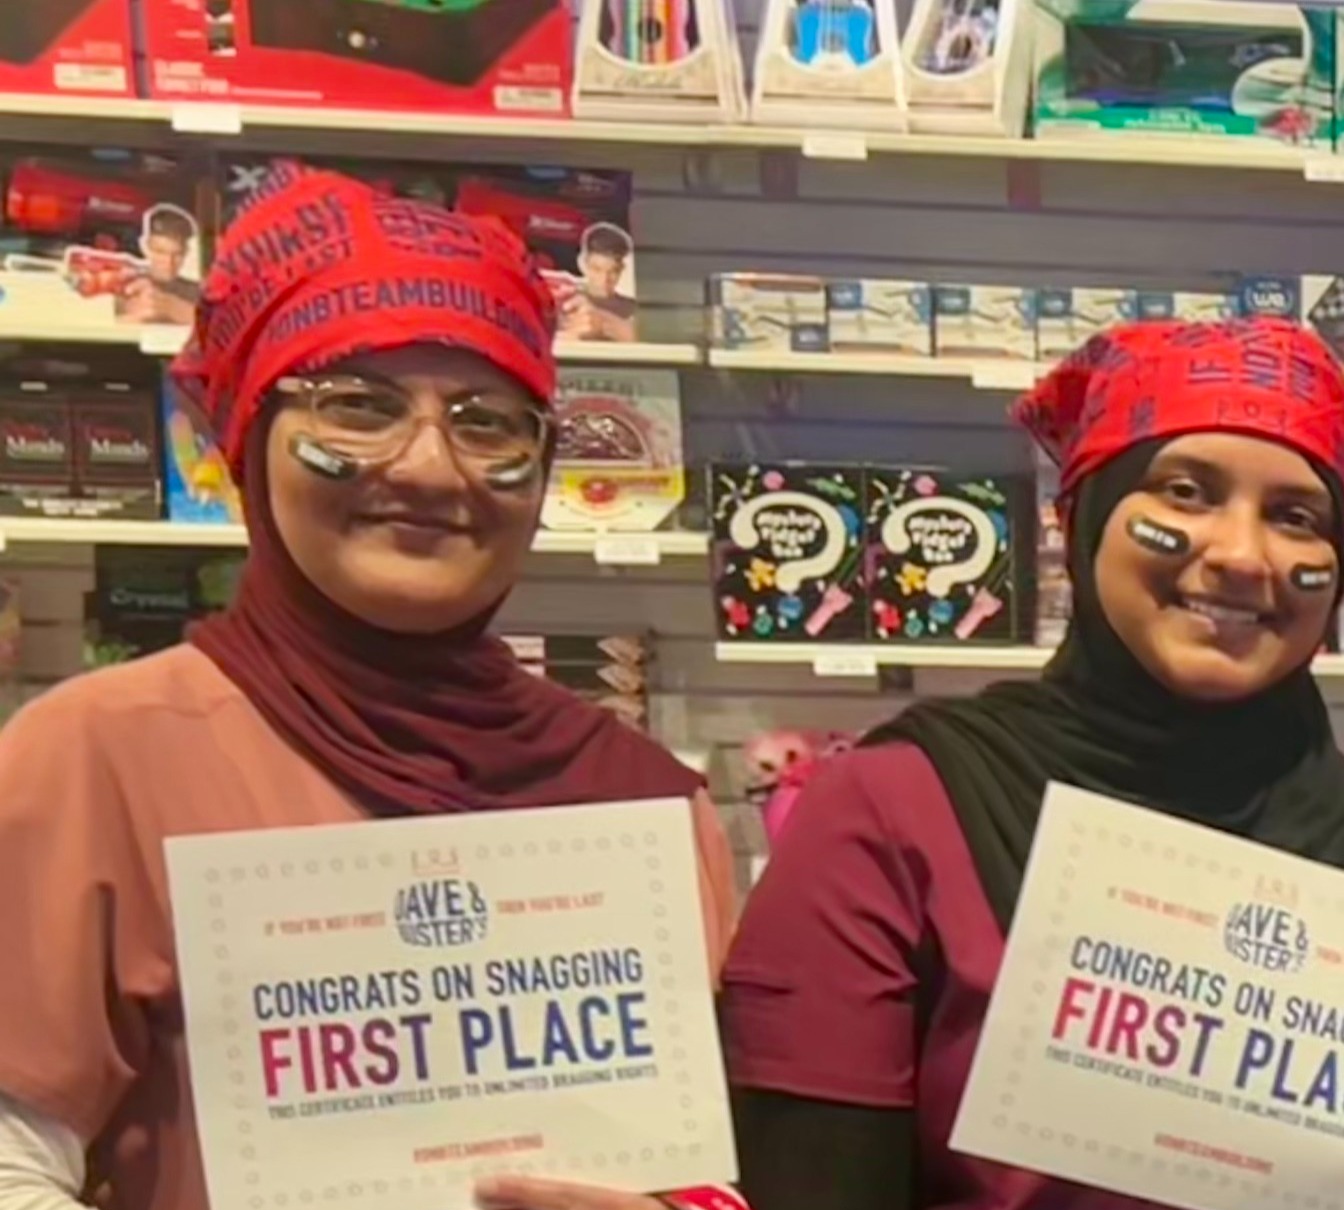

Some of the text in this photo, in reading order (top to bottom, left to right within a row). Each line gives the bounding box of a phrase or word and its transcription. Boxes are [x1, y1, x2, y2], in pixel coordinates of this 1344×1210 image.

[253, 948, 643, 1019] CONGRATS ON SNAGGING
[1070, 933, 1226, 1008] CONGRATS
[1232, 982, 1274, 1022] ON
[259, 992, 653, 1096] FIRST PLACE
[1051, 975, 1223, 1080] FIRST
